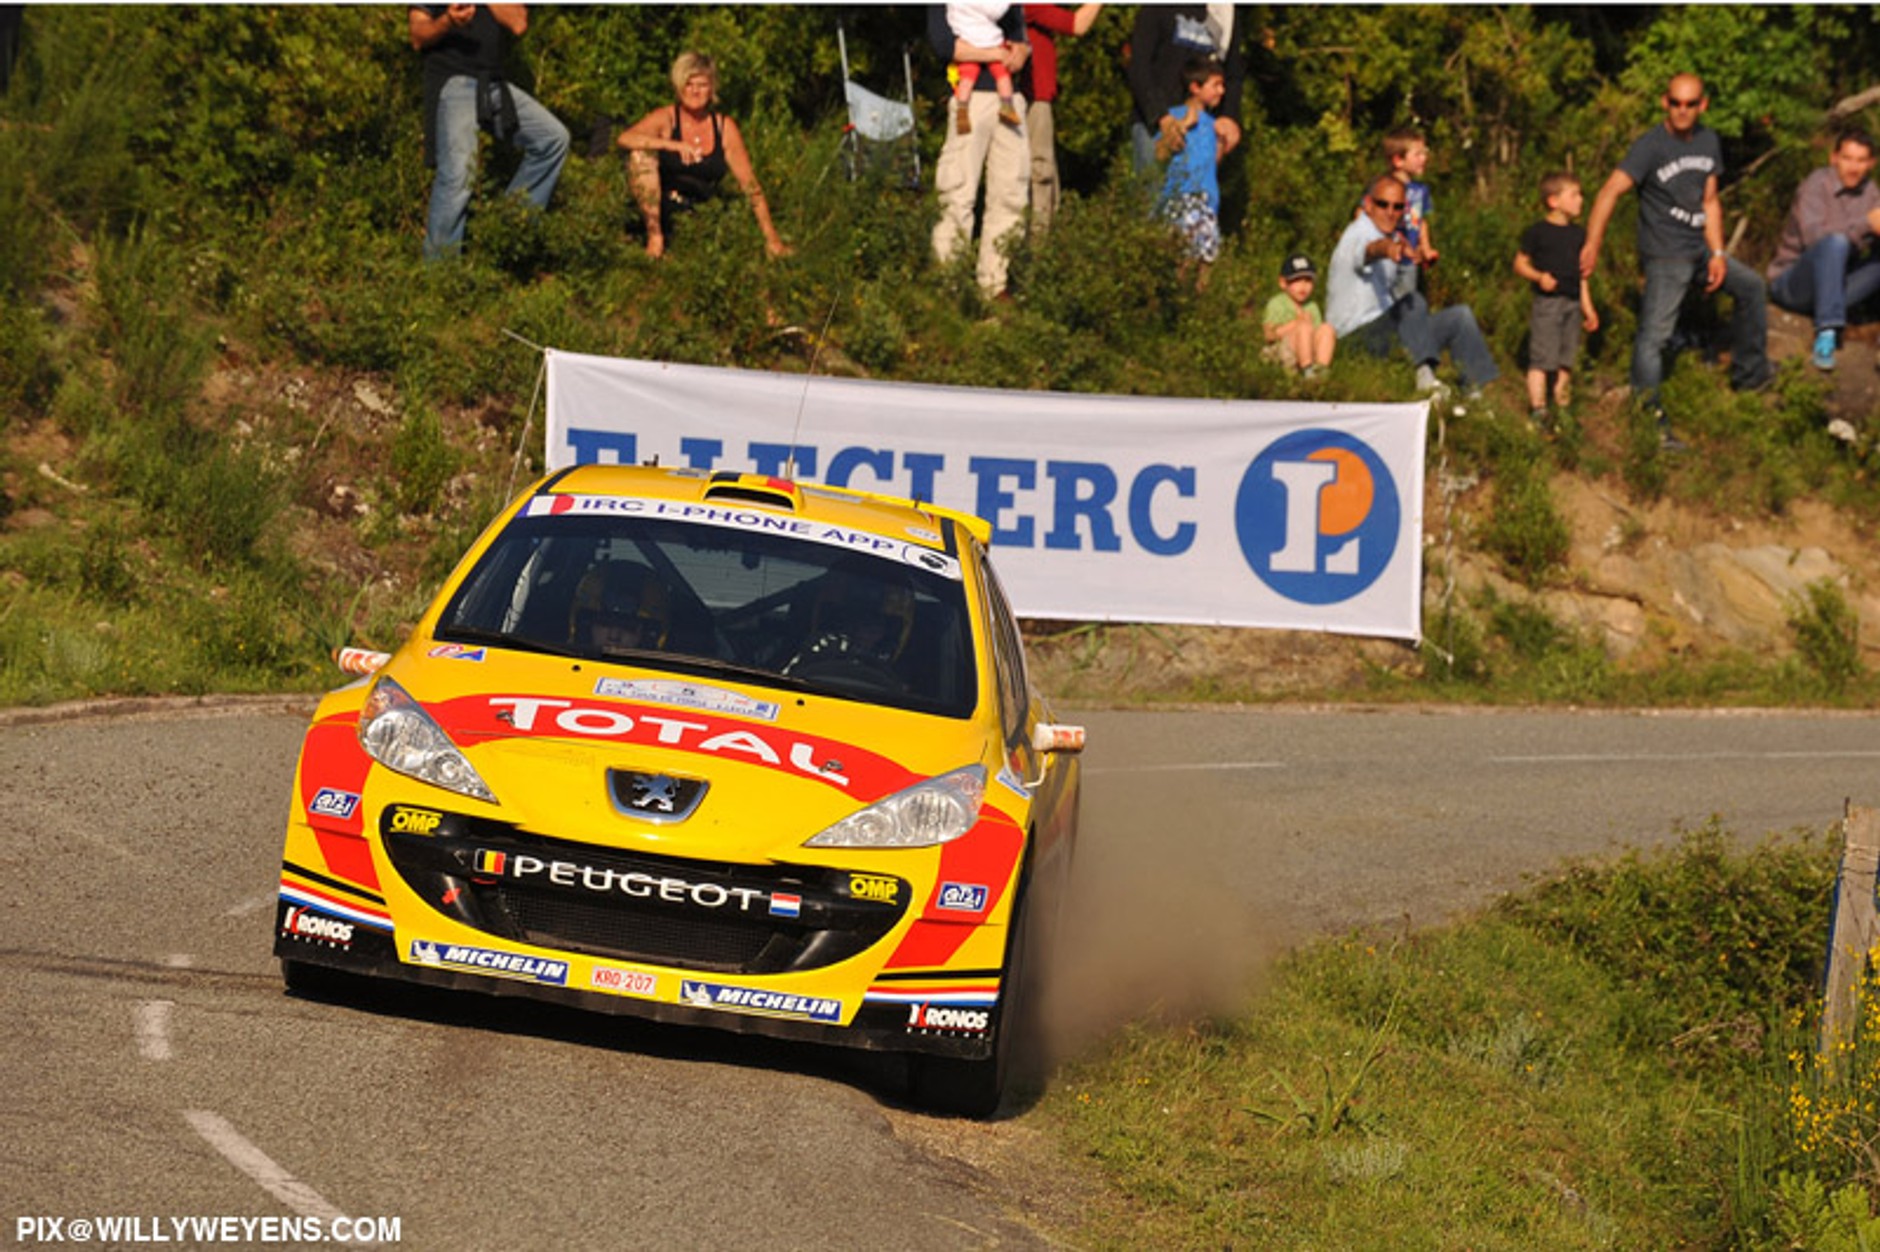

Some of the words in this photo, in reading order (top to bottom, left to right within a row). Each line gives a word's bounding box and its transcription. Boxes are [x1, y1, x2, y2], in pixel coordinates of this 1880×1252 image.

[582, 498, 645, 513] IRC
[657, 503, 811, 535] I-PHONE
[823, 528, 894, 552] APP
[488, 697, 849, 786] TOTAL
[392, 812, 441, 832] OMP
[513, 856, 762, 911] PEUGEOT
[849, 881, 898, 901] OMP
[283, 905, 355, 942] KRONOS
[443, 946, 565, 980] MICHELIN
[716, 987, 839, 1016] MICHELIN
[909, 1000, 989, 1030] KRONOS
